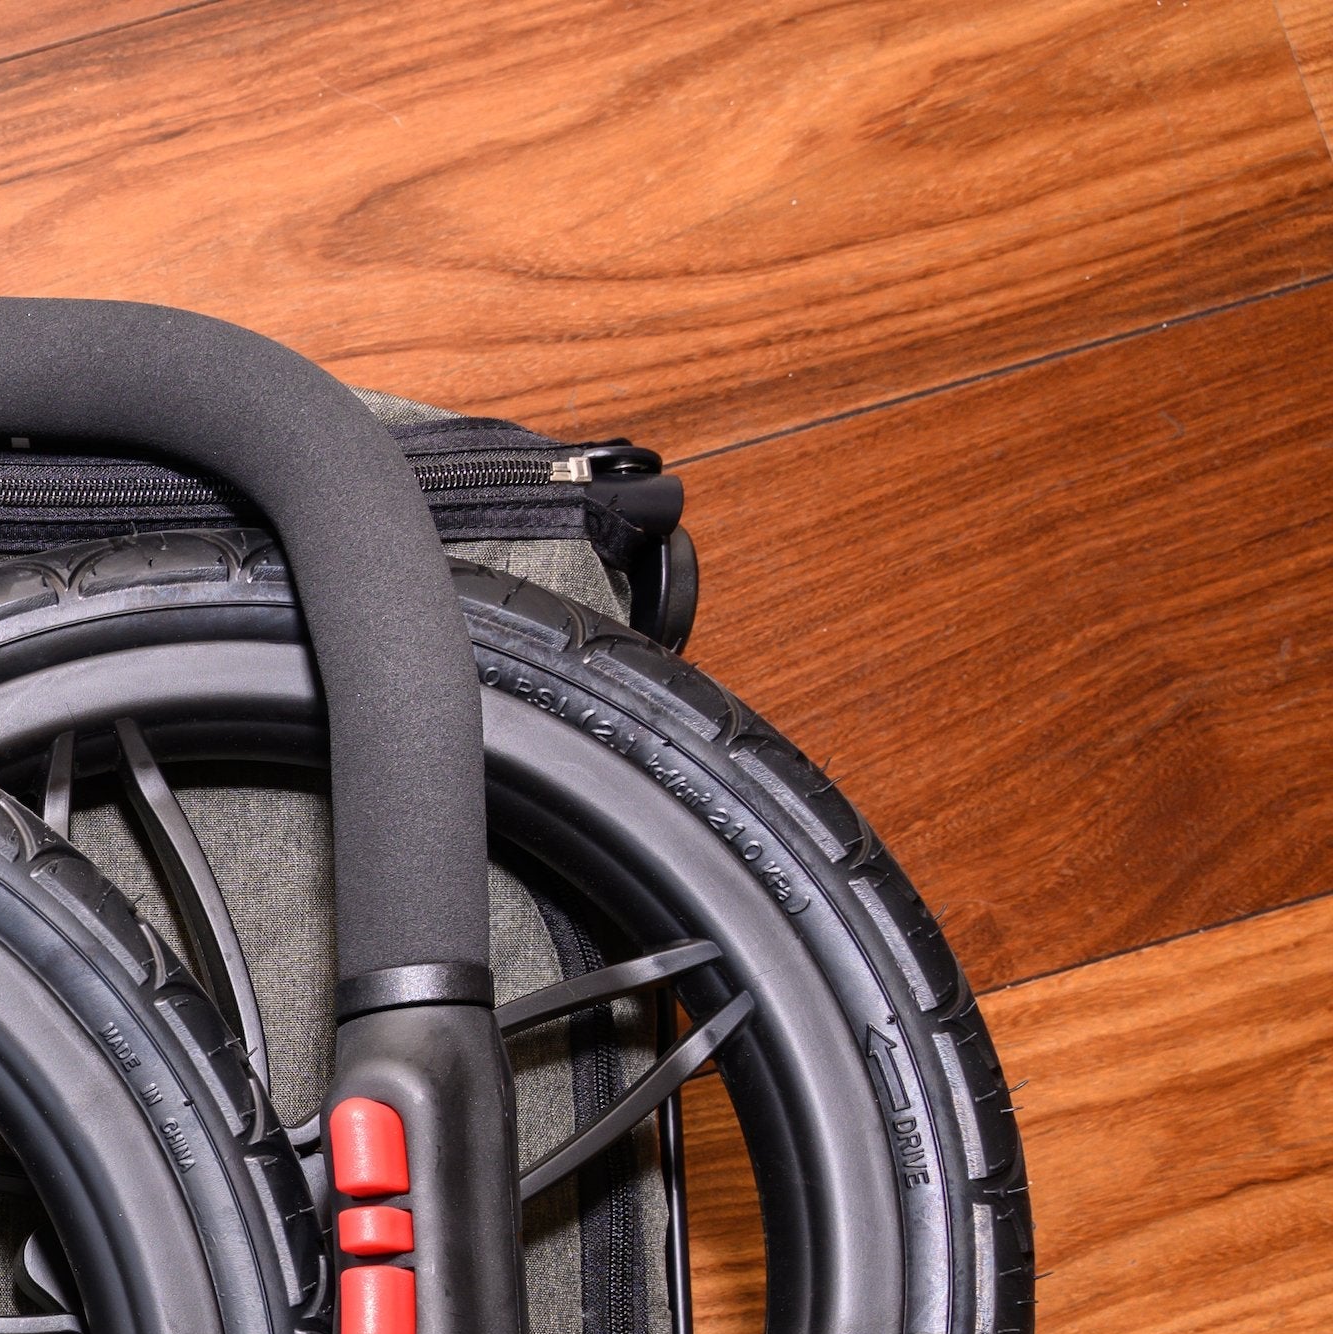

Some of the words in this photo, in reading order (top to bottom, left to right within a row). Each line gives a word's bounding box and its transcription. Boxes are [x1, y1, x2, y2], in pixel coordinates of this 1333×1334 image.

[98, 1021, 140, 1075] MADE
[141, 1082, 164, 1107] IN
[160, 1115, 197, 1176] CHINA
[892, 1118, 932, 1190] DRIVE
